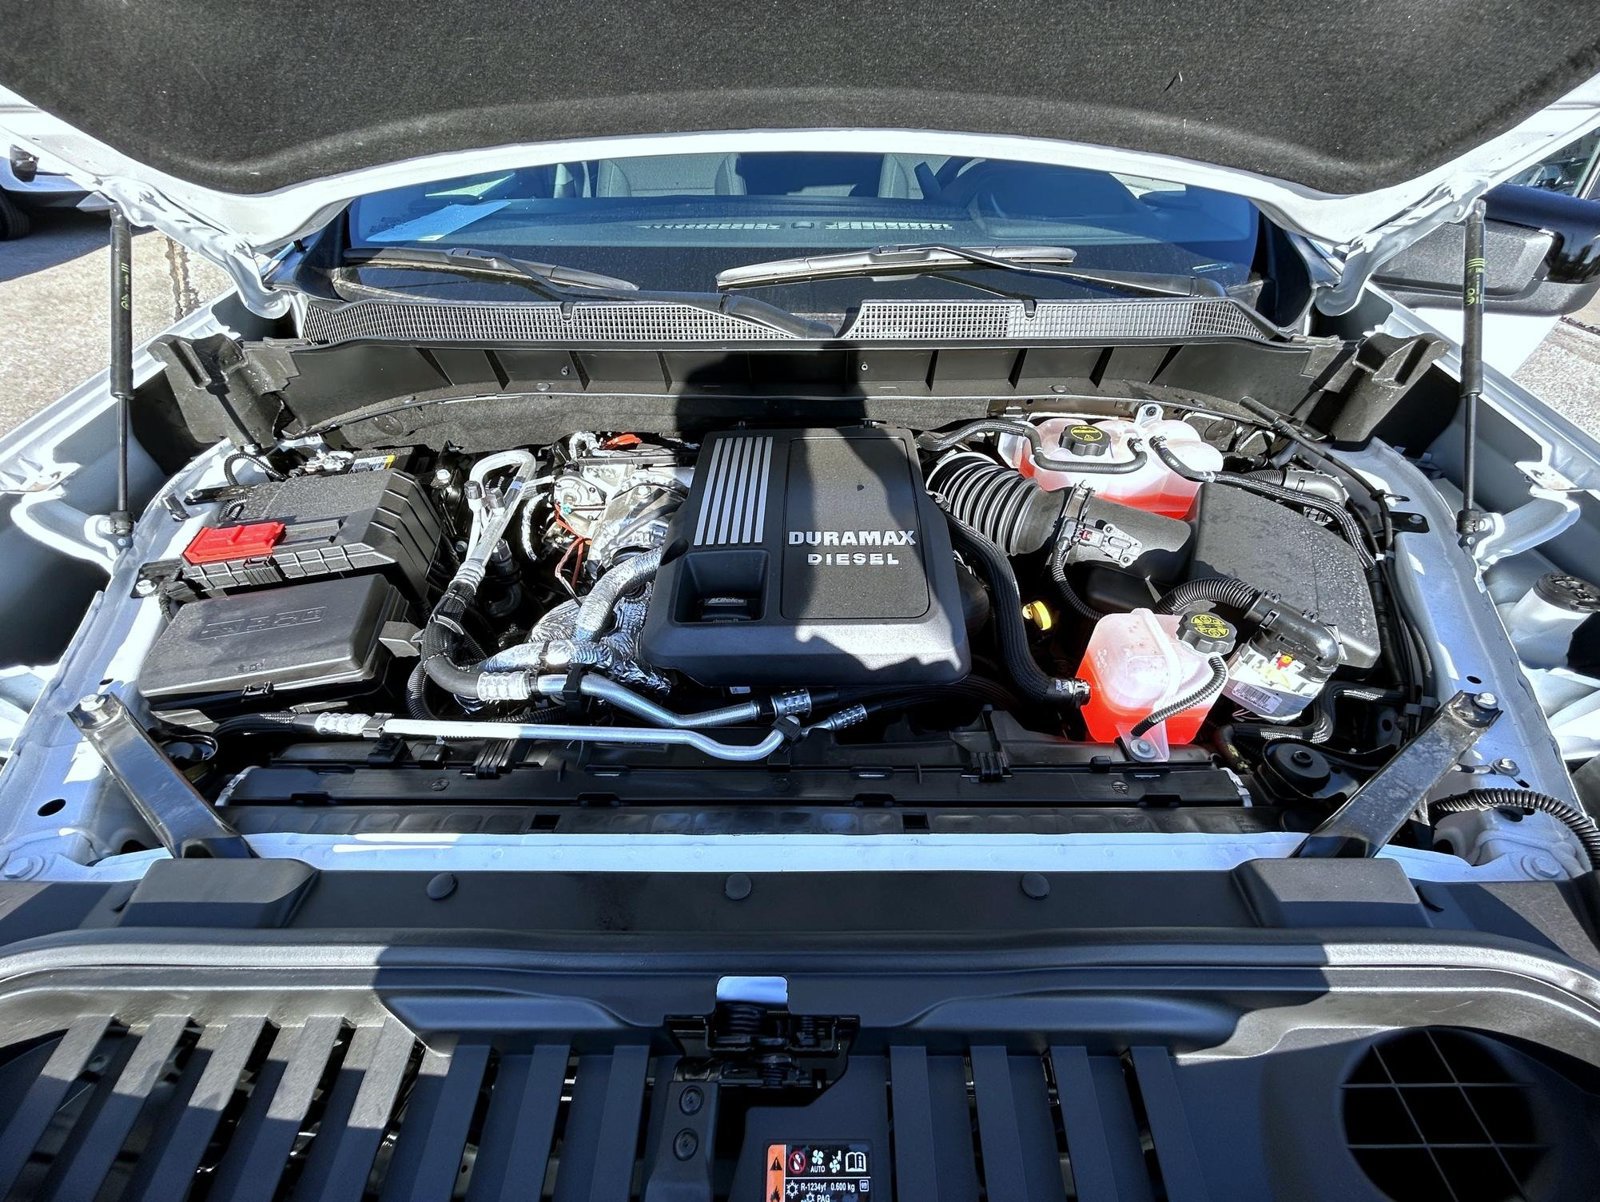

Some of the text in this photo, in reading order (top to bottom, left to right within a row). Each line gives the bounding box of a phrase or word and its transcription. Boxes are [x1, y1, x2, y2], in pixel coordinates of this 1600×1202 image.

[788, 530, 916, 546] DURAMAX
[807, 553, 900, 566] DIESEL
[810, 1165, 826, 1173] AUTO
[800, 1182, 827, 1192] R-1234yf
[847, 1182, 855, 1192] kg
[816, 1194, 831, 1202] PAG
